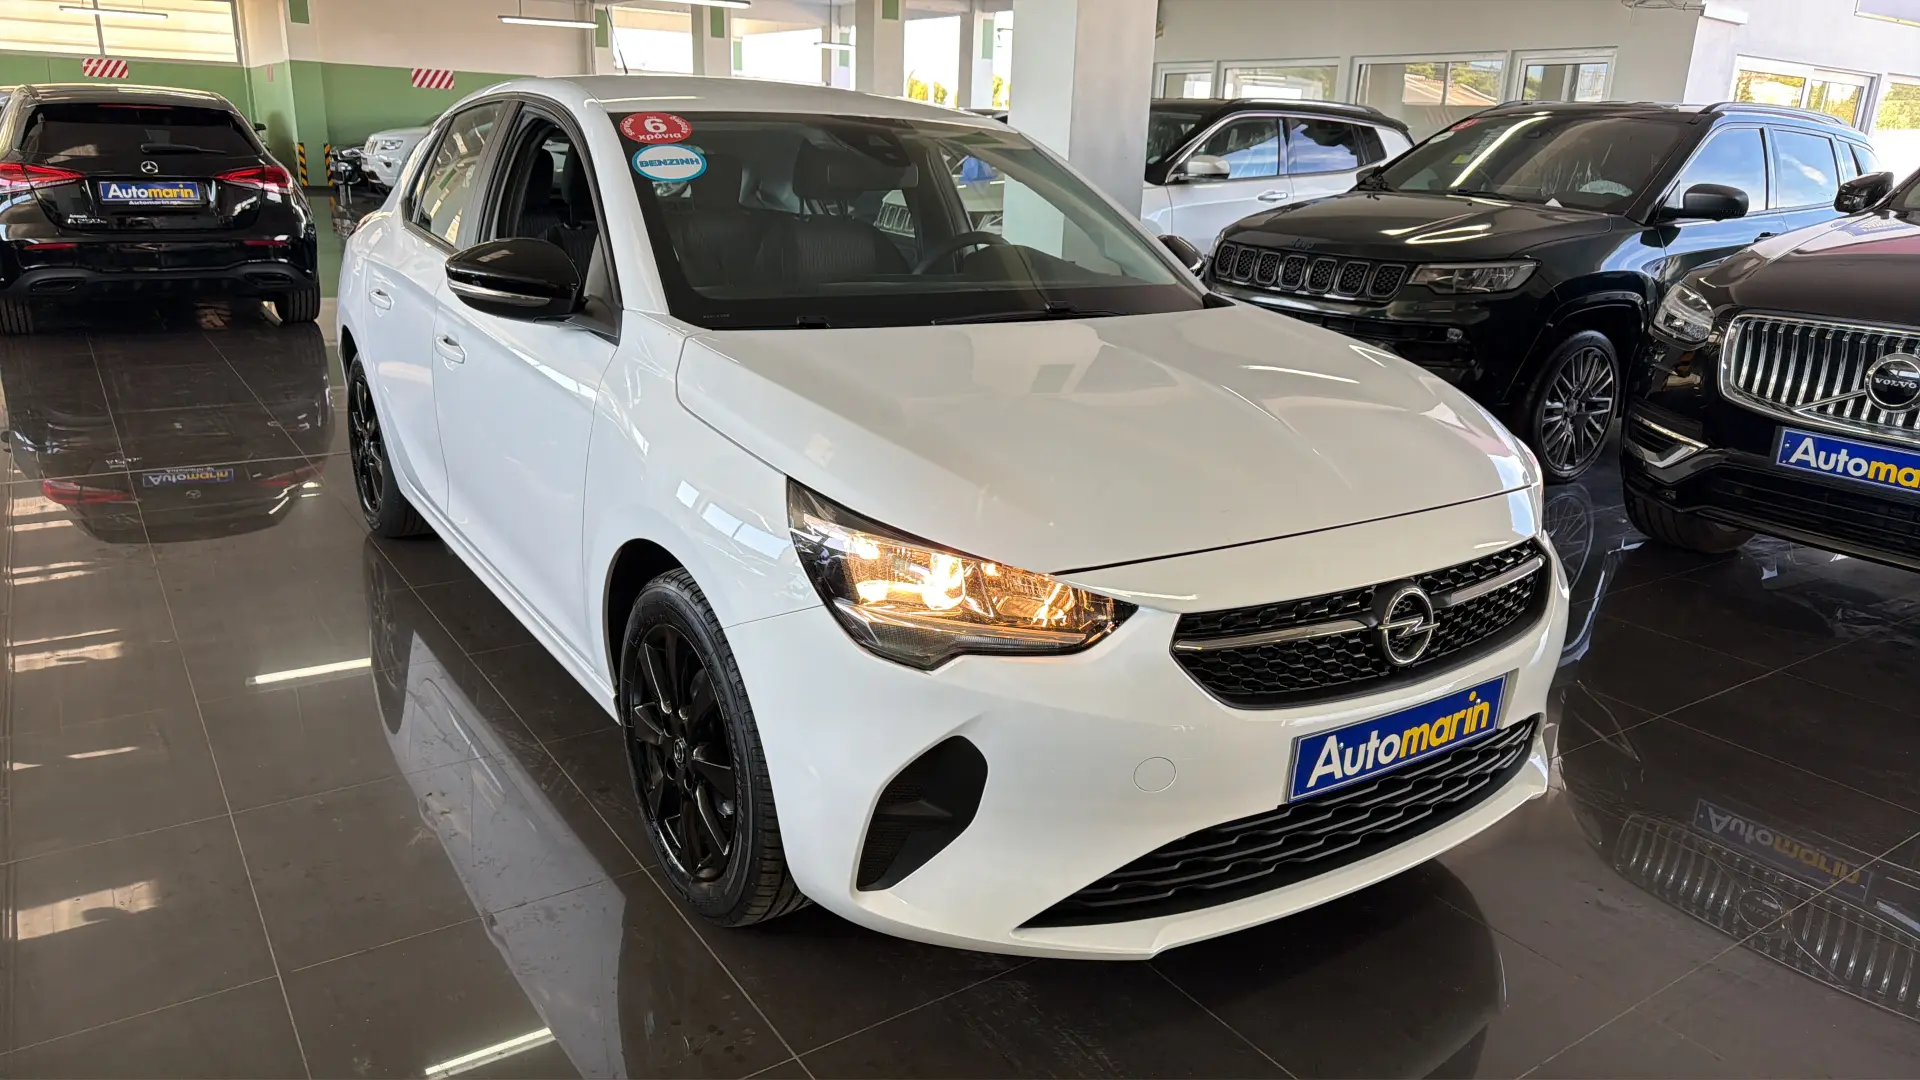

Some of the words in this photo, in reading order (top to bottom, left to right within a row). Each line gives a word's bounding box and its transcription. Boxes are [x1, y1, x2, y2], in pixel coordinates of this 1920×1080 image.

[644, 118, 667, 133] 6
[638, 132, 682, 140] χρόνια
[108, 184, 194, 198] Automarin
[1874, 378, 1917, 389] VOLVO
[1306, 691, 1490, 788] Automarin
